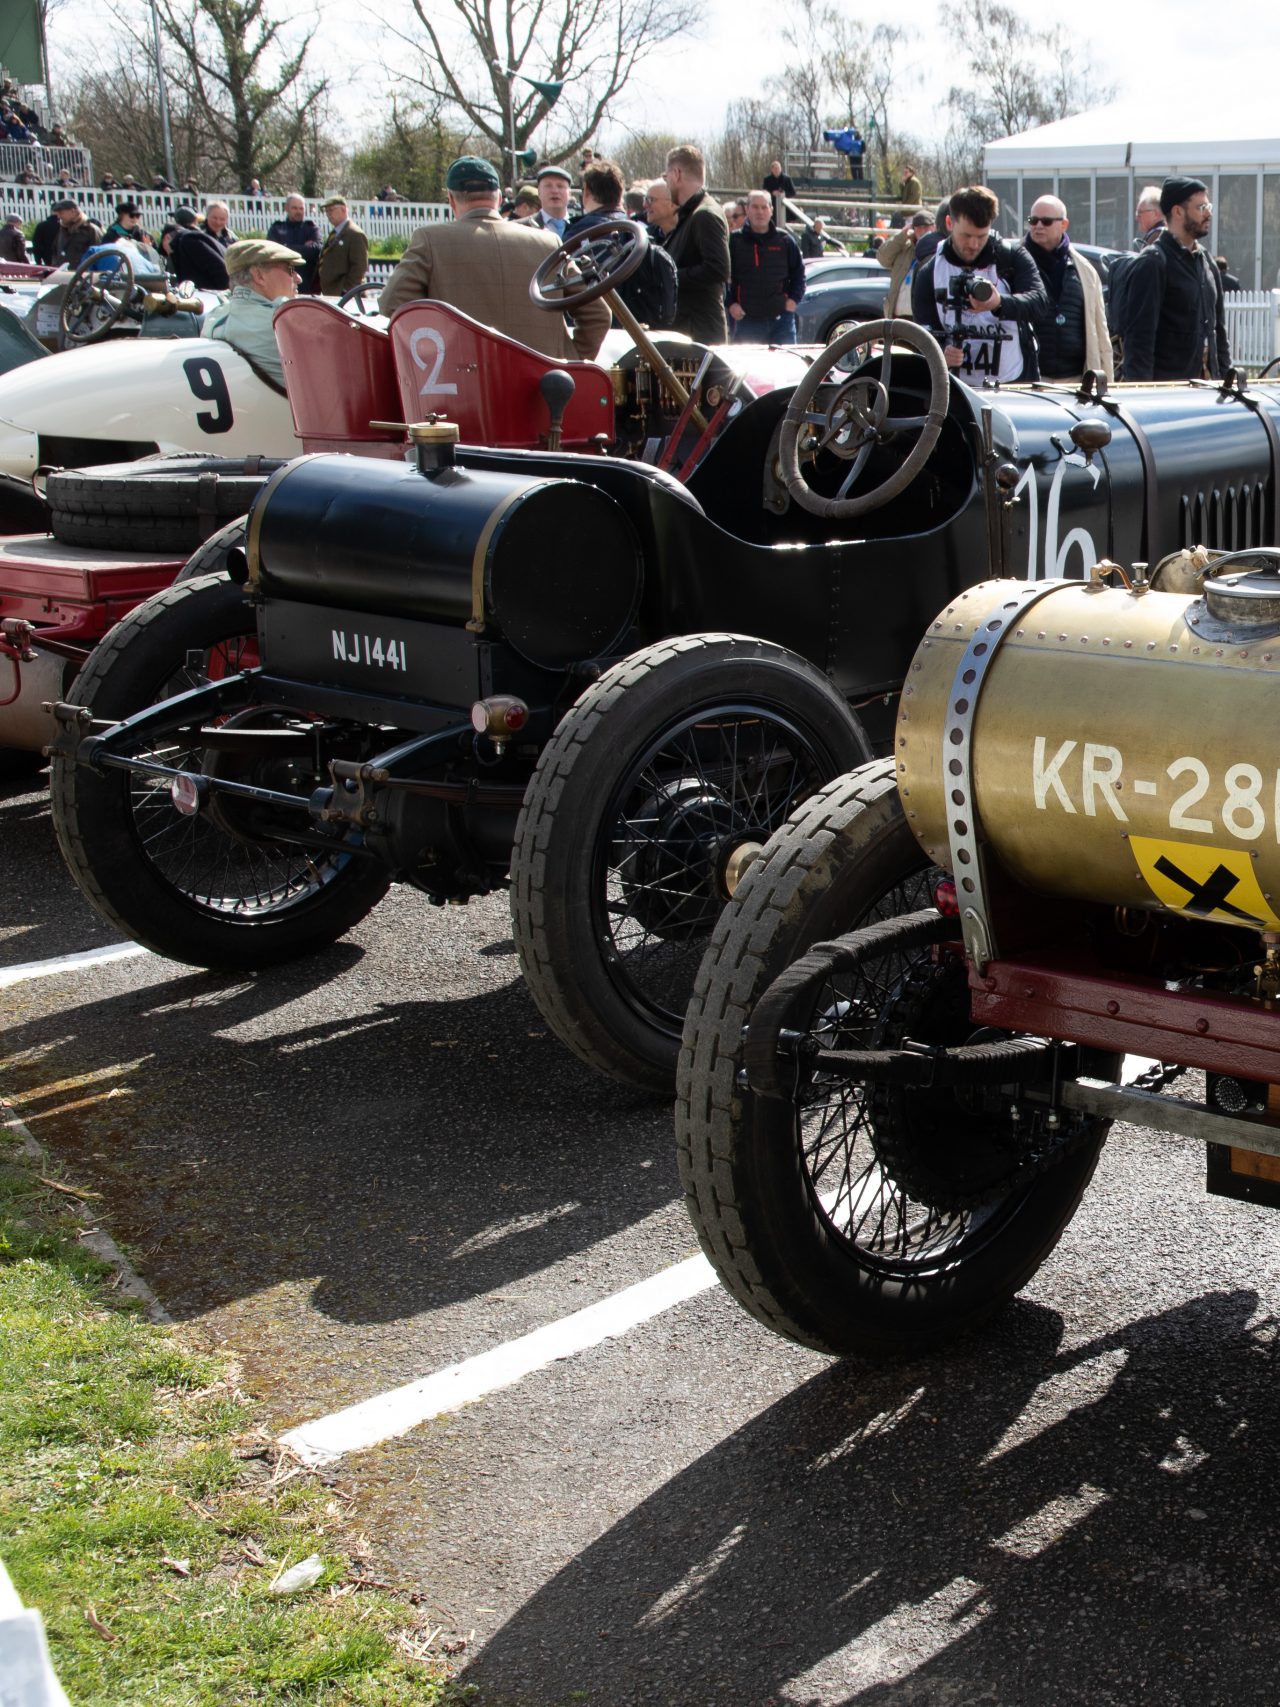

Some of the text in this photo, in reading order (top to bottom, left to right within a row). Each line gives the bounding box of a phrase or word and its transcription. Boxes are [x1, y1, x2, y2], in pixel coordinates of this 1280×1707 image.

[183, 357, 234, 434] 9
[410, 327, 457, 395] 2
[1014, 453, 1100, 581] 16
[332, 630, 406, 671] NJ1441
